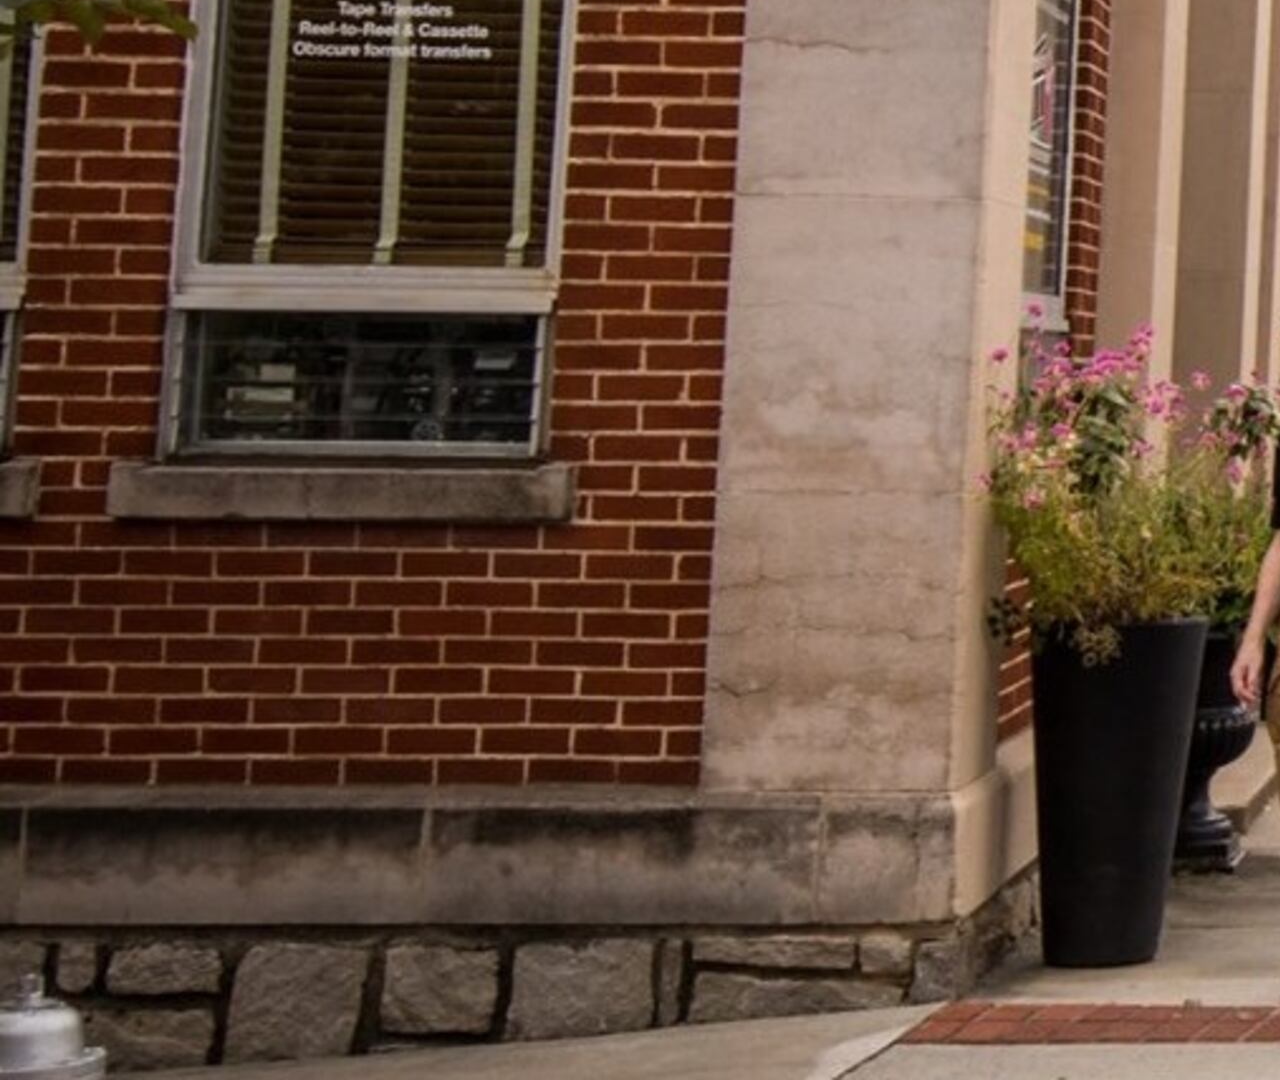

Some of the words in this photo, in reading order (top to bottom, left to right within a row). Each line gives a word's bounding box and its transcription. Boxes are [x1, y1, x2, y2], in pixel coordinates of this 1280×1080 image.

[337, 0, 376, 18] Tape
[379, 1, 454, 17] Transfers
[299, 21, 399, 37] Reel-to-Reel
[402, 23, 414, 37] &
[418, 24, 489, 38] Cassette
[292, 41, 360, 57] Obscure
[363, 42, 417, 57] format
[420, 44, 493, 59] transfers
